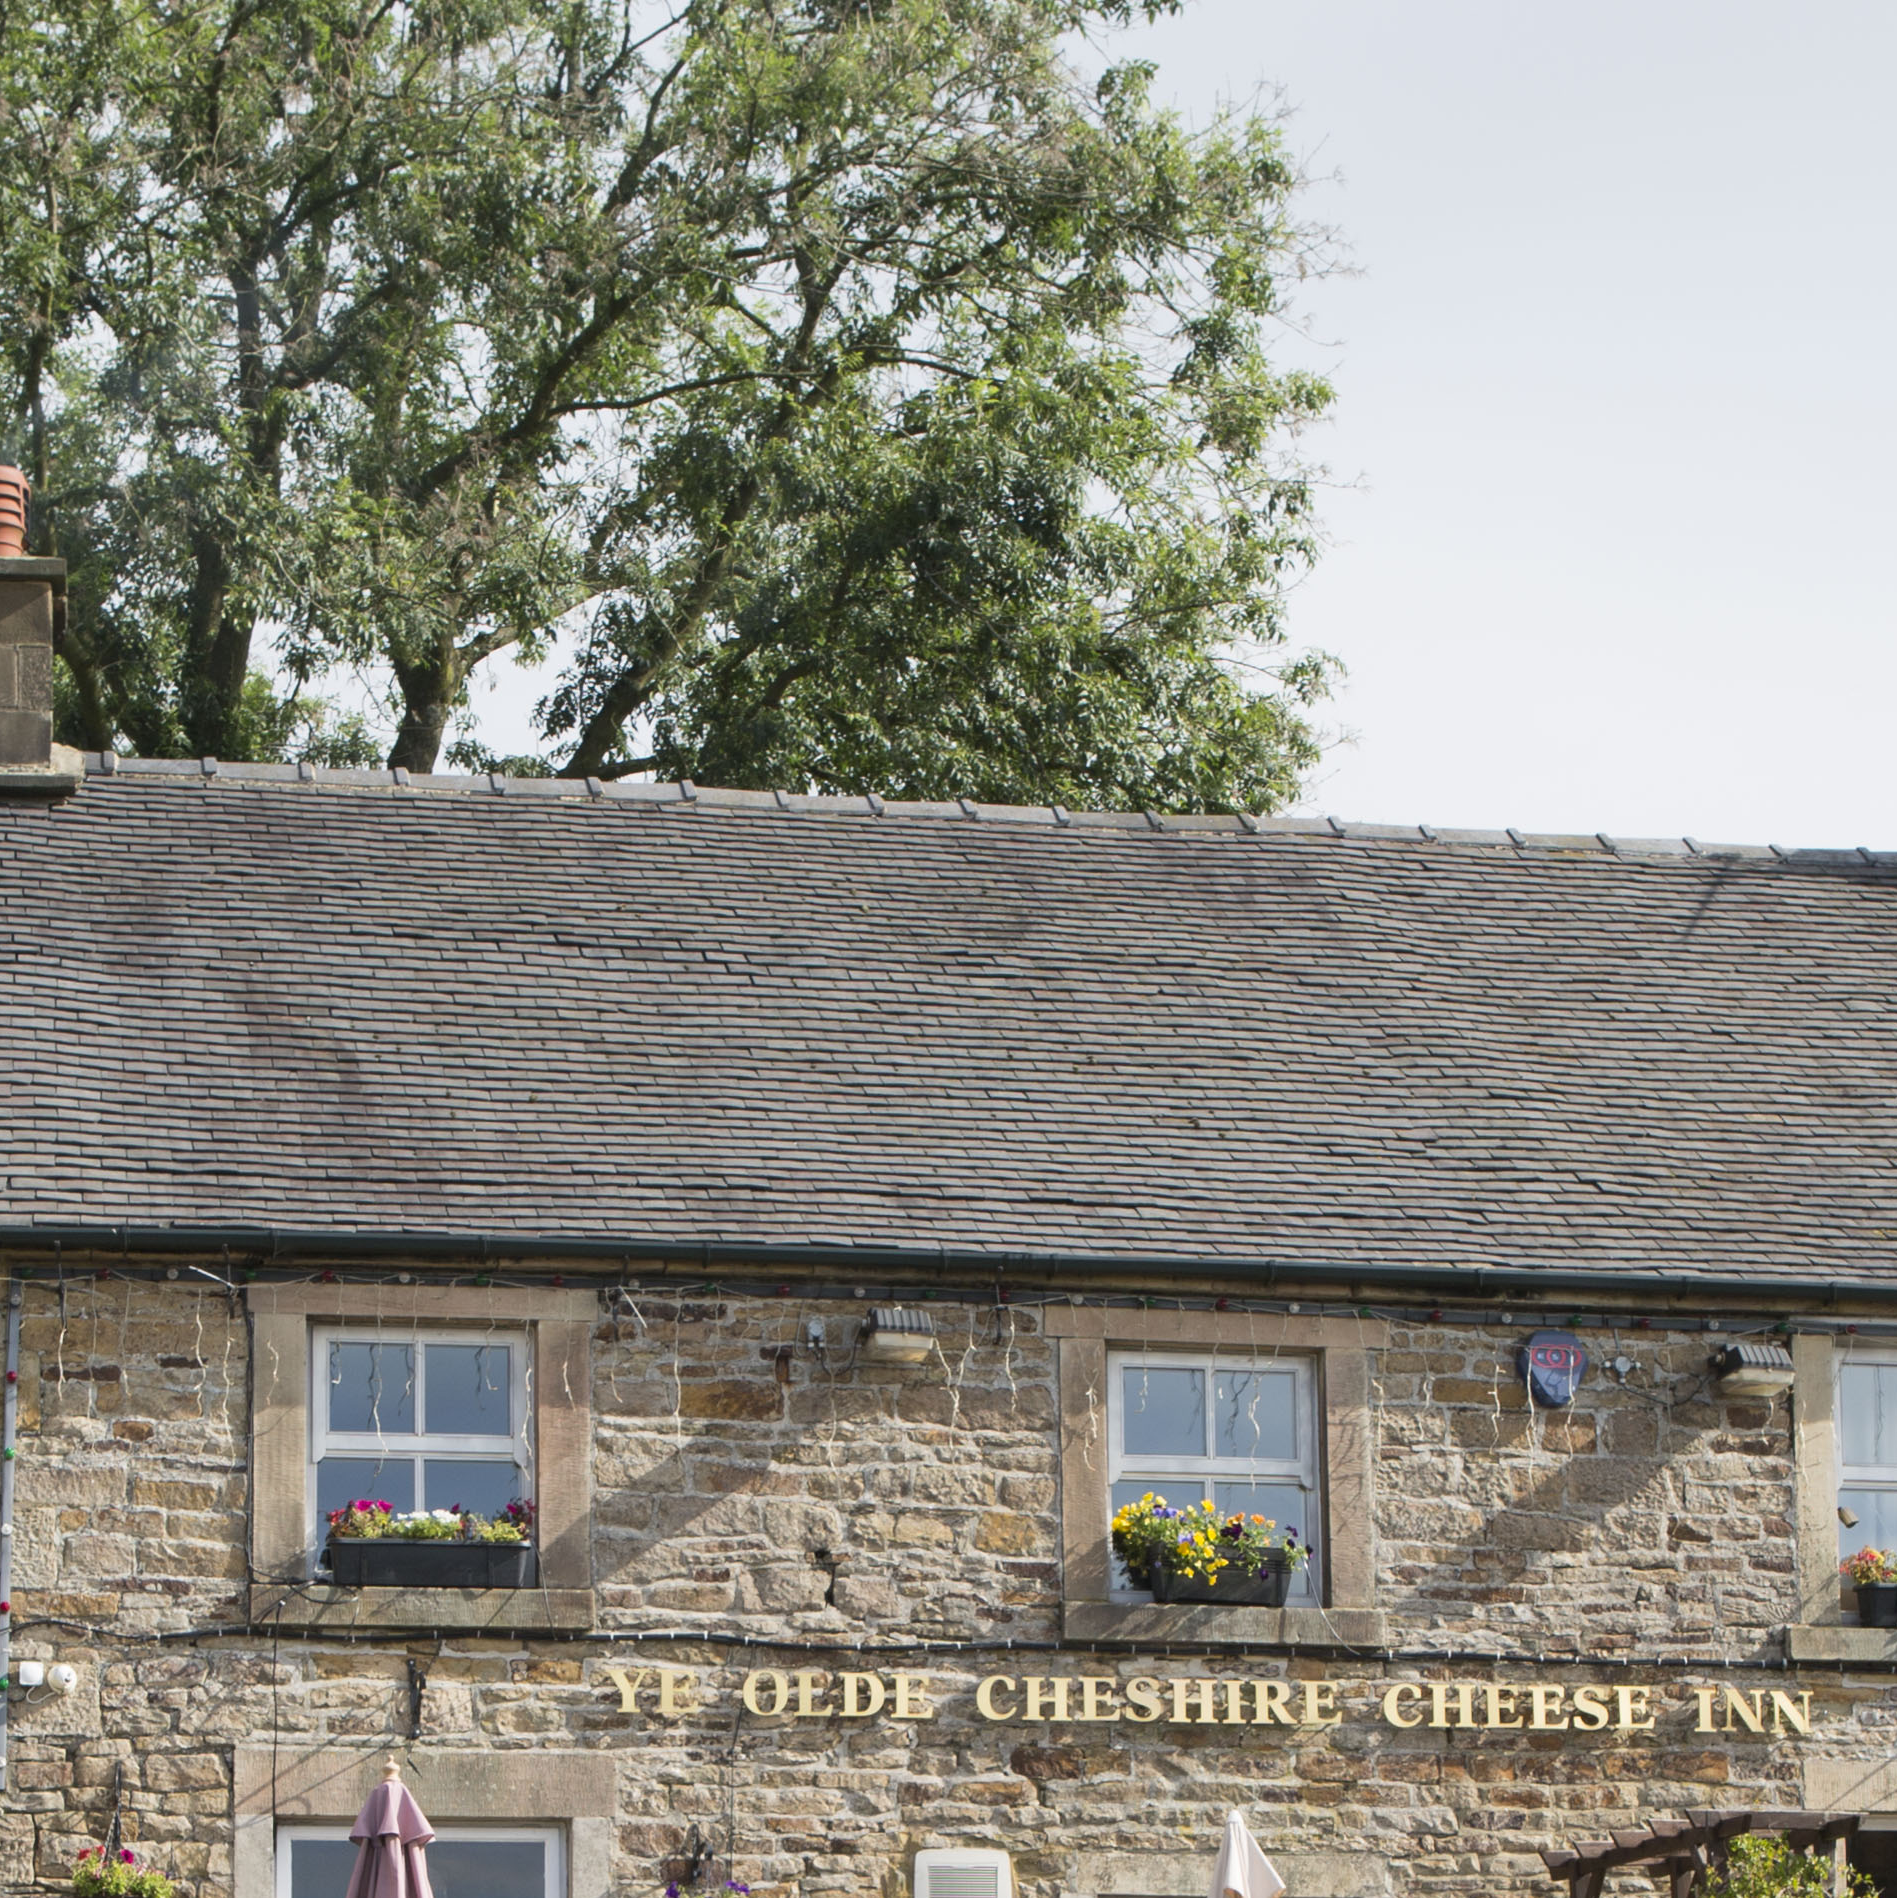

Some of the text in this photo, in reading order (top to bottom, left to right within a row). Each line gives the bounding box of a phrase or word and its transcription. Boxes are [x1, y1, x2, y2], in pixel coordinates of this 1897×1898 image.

[606, 1668, 1814, 1734] YE OLDE CHESHIRE CHEESE INN
